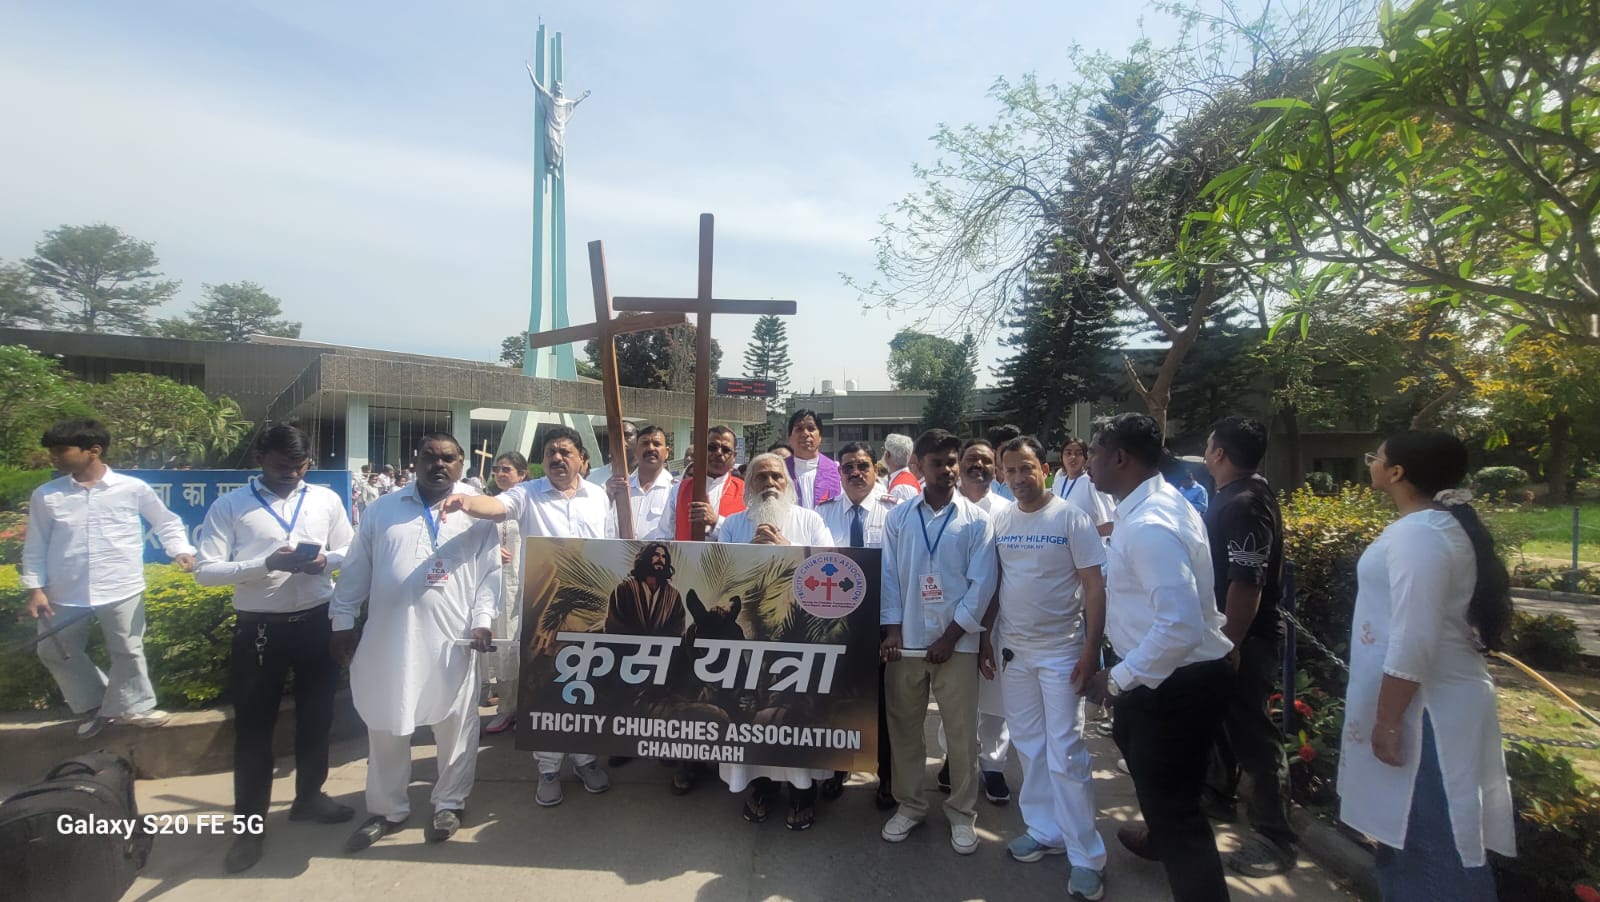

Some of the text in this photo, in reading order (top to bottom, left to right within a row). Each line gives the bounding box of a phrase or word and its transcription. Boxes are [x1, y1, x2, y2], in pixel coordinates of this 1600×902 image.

[182, 482, 207, 507] का
[1026, 535, 1069, 546] HILFIGER
[800, 556, 838, 575] CHURCHES
[839, 559, 863, 601] ASSOCIATION
[553, 631, 847, 705] क्रूस यात्रा
[529, 711, 861, 750] TRICITY CHURCHES ASSOCIATION
[637, 740, 745, 762] CHANDIGARH
